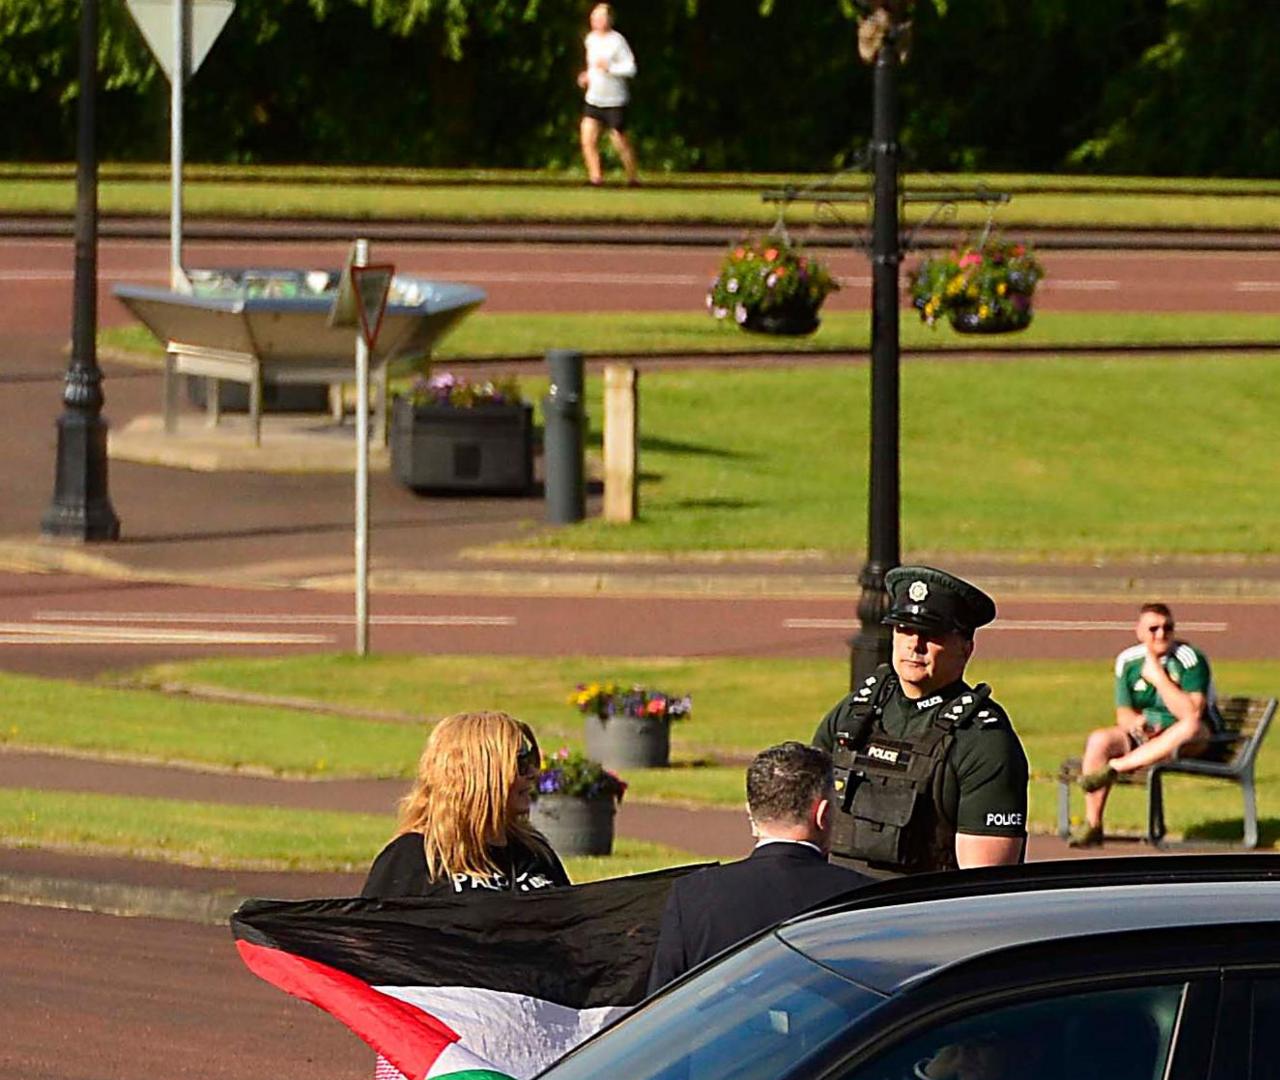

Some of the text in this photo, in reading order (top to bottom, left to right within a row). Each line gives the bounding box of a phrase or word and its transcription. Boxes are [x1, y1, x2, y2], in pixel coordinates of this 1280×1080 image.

[916, 695, 943, 710] POLICE
[868, 746, 898, 762] POLICE
[986, 813, 1022, 826] POLICE
